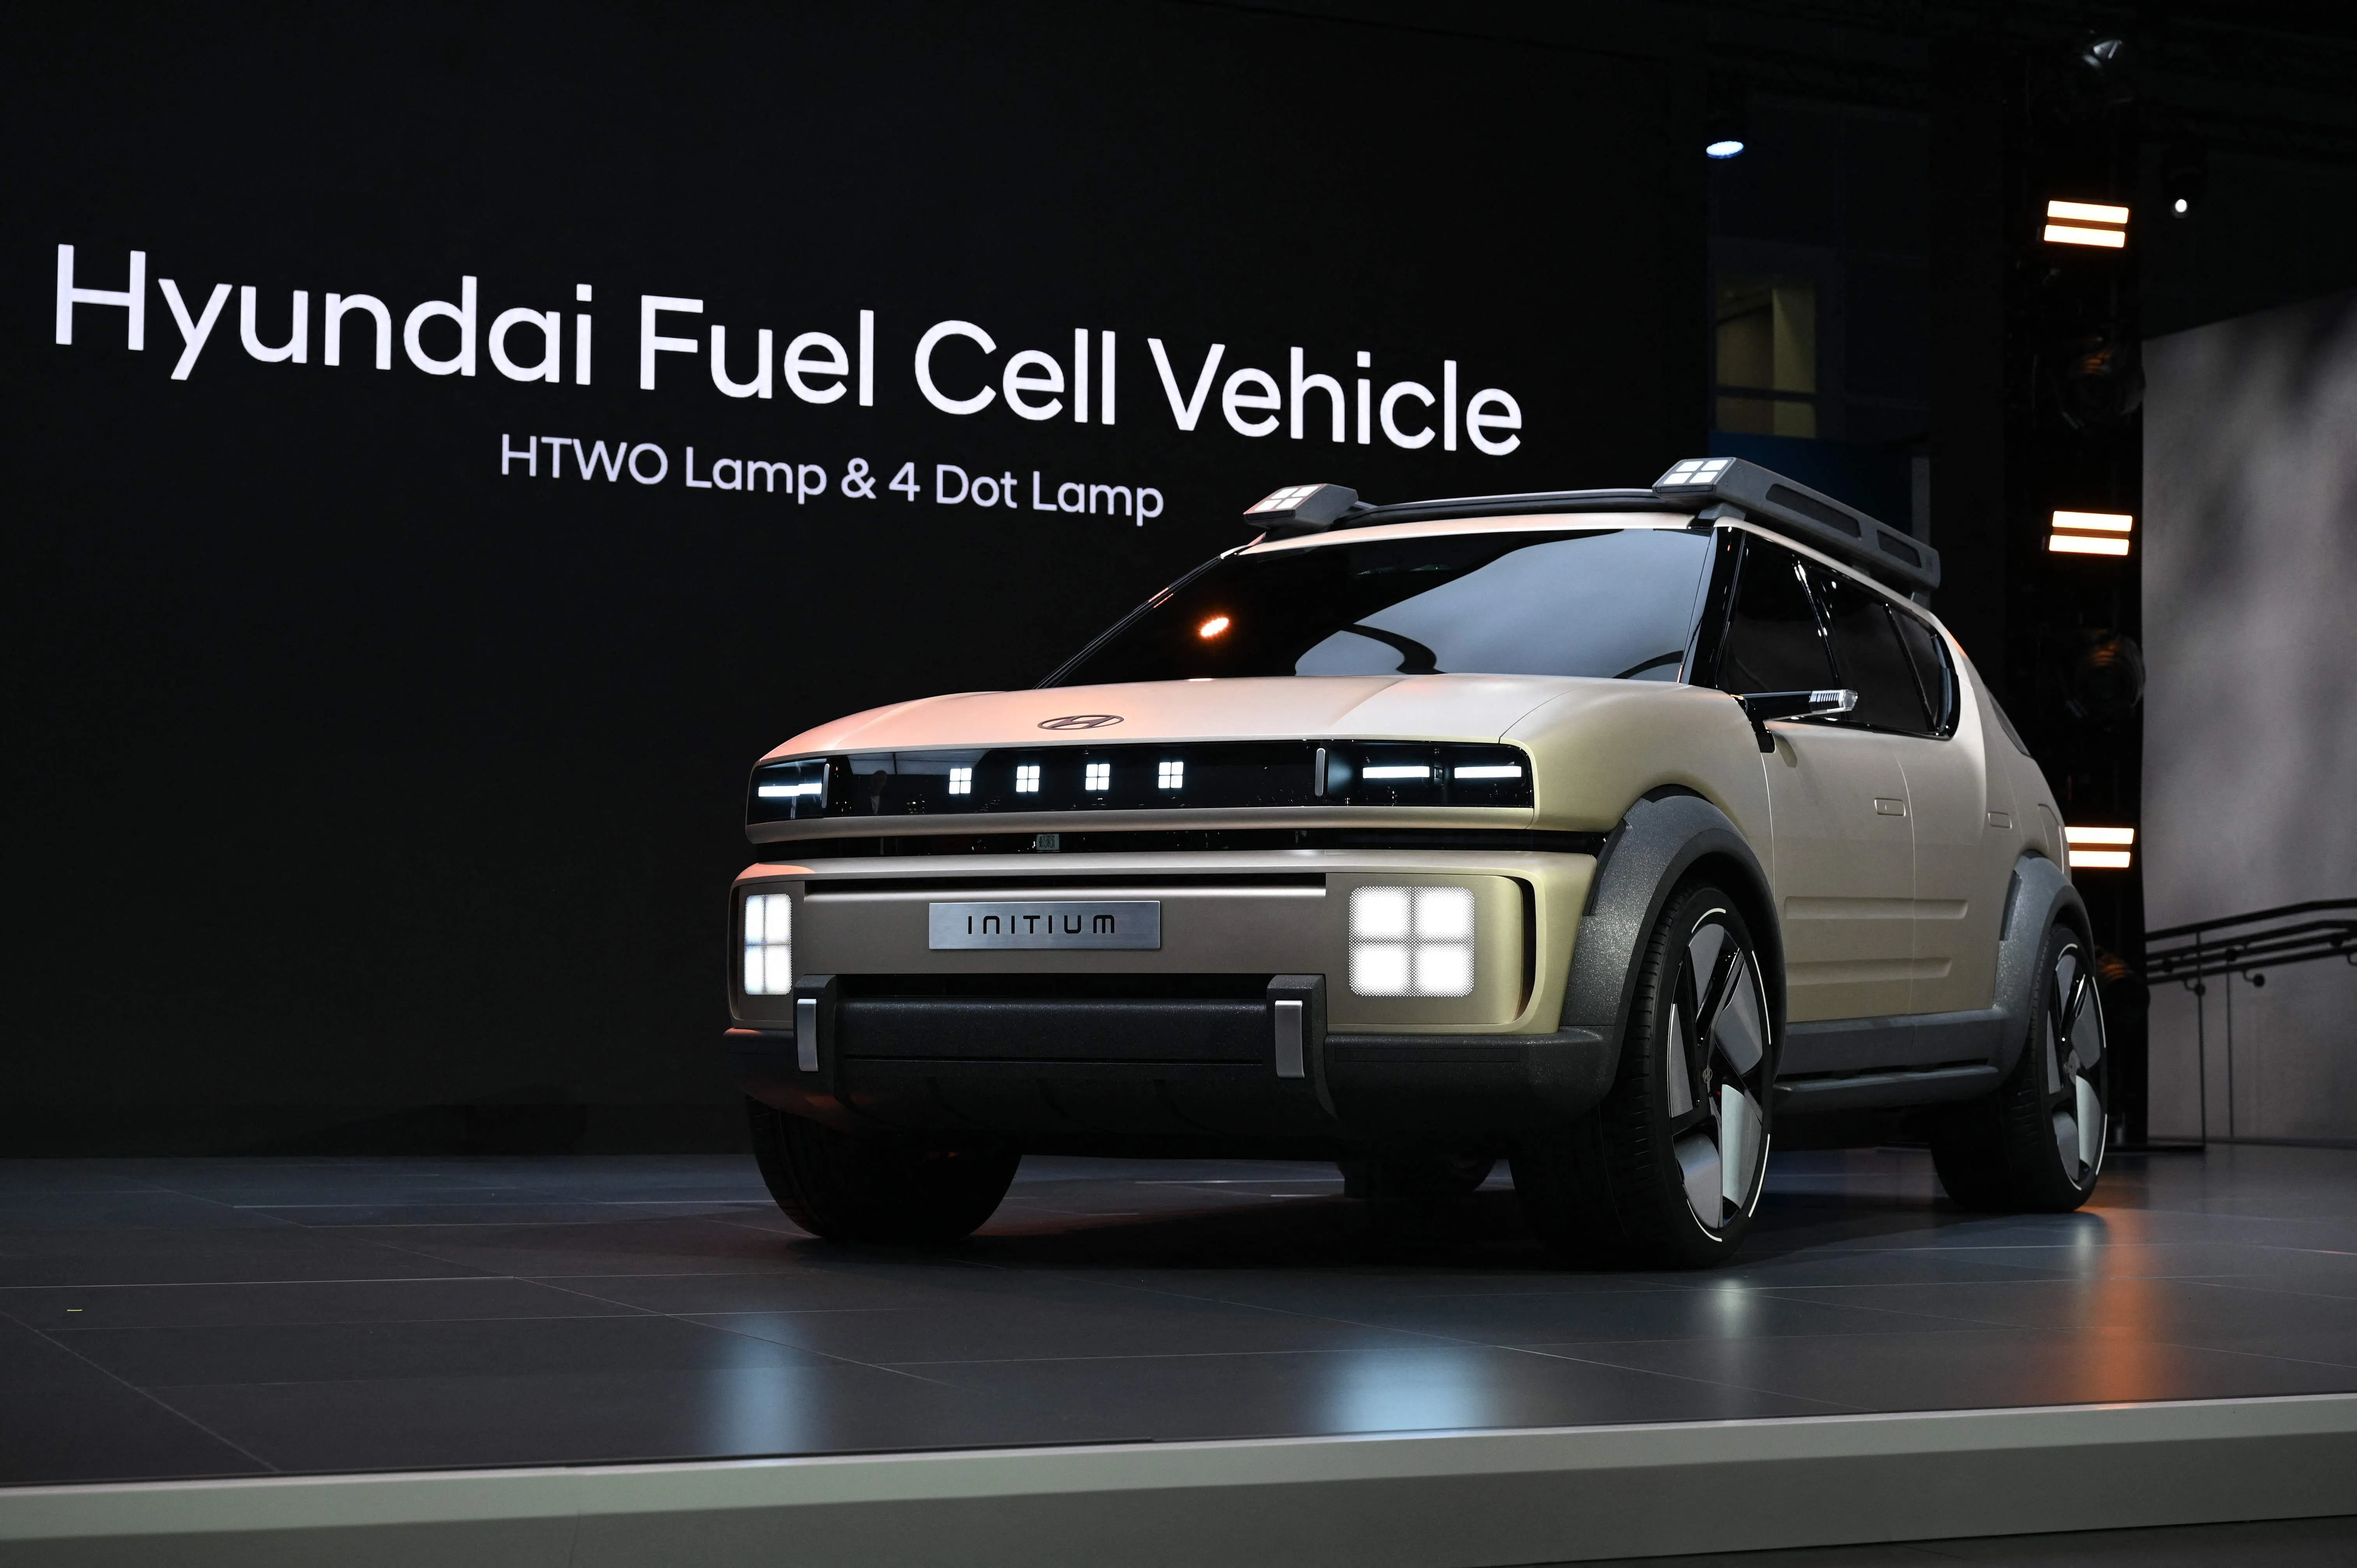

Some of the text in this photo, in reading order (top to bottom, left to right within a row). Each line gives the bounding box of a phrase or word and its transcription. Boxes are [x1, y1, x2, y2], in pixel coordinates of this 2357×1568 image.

[56, 244, 1522, 456] Hyundai Fuel Cell Vehicle
[501, 434, 1164, 527] HTWO Lamp & 4 Dot Lamp
